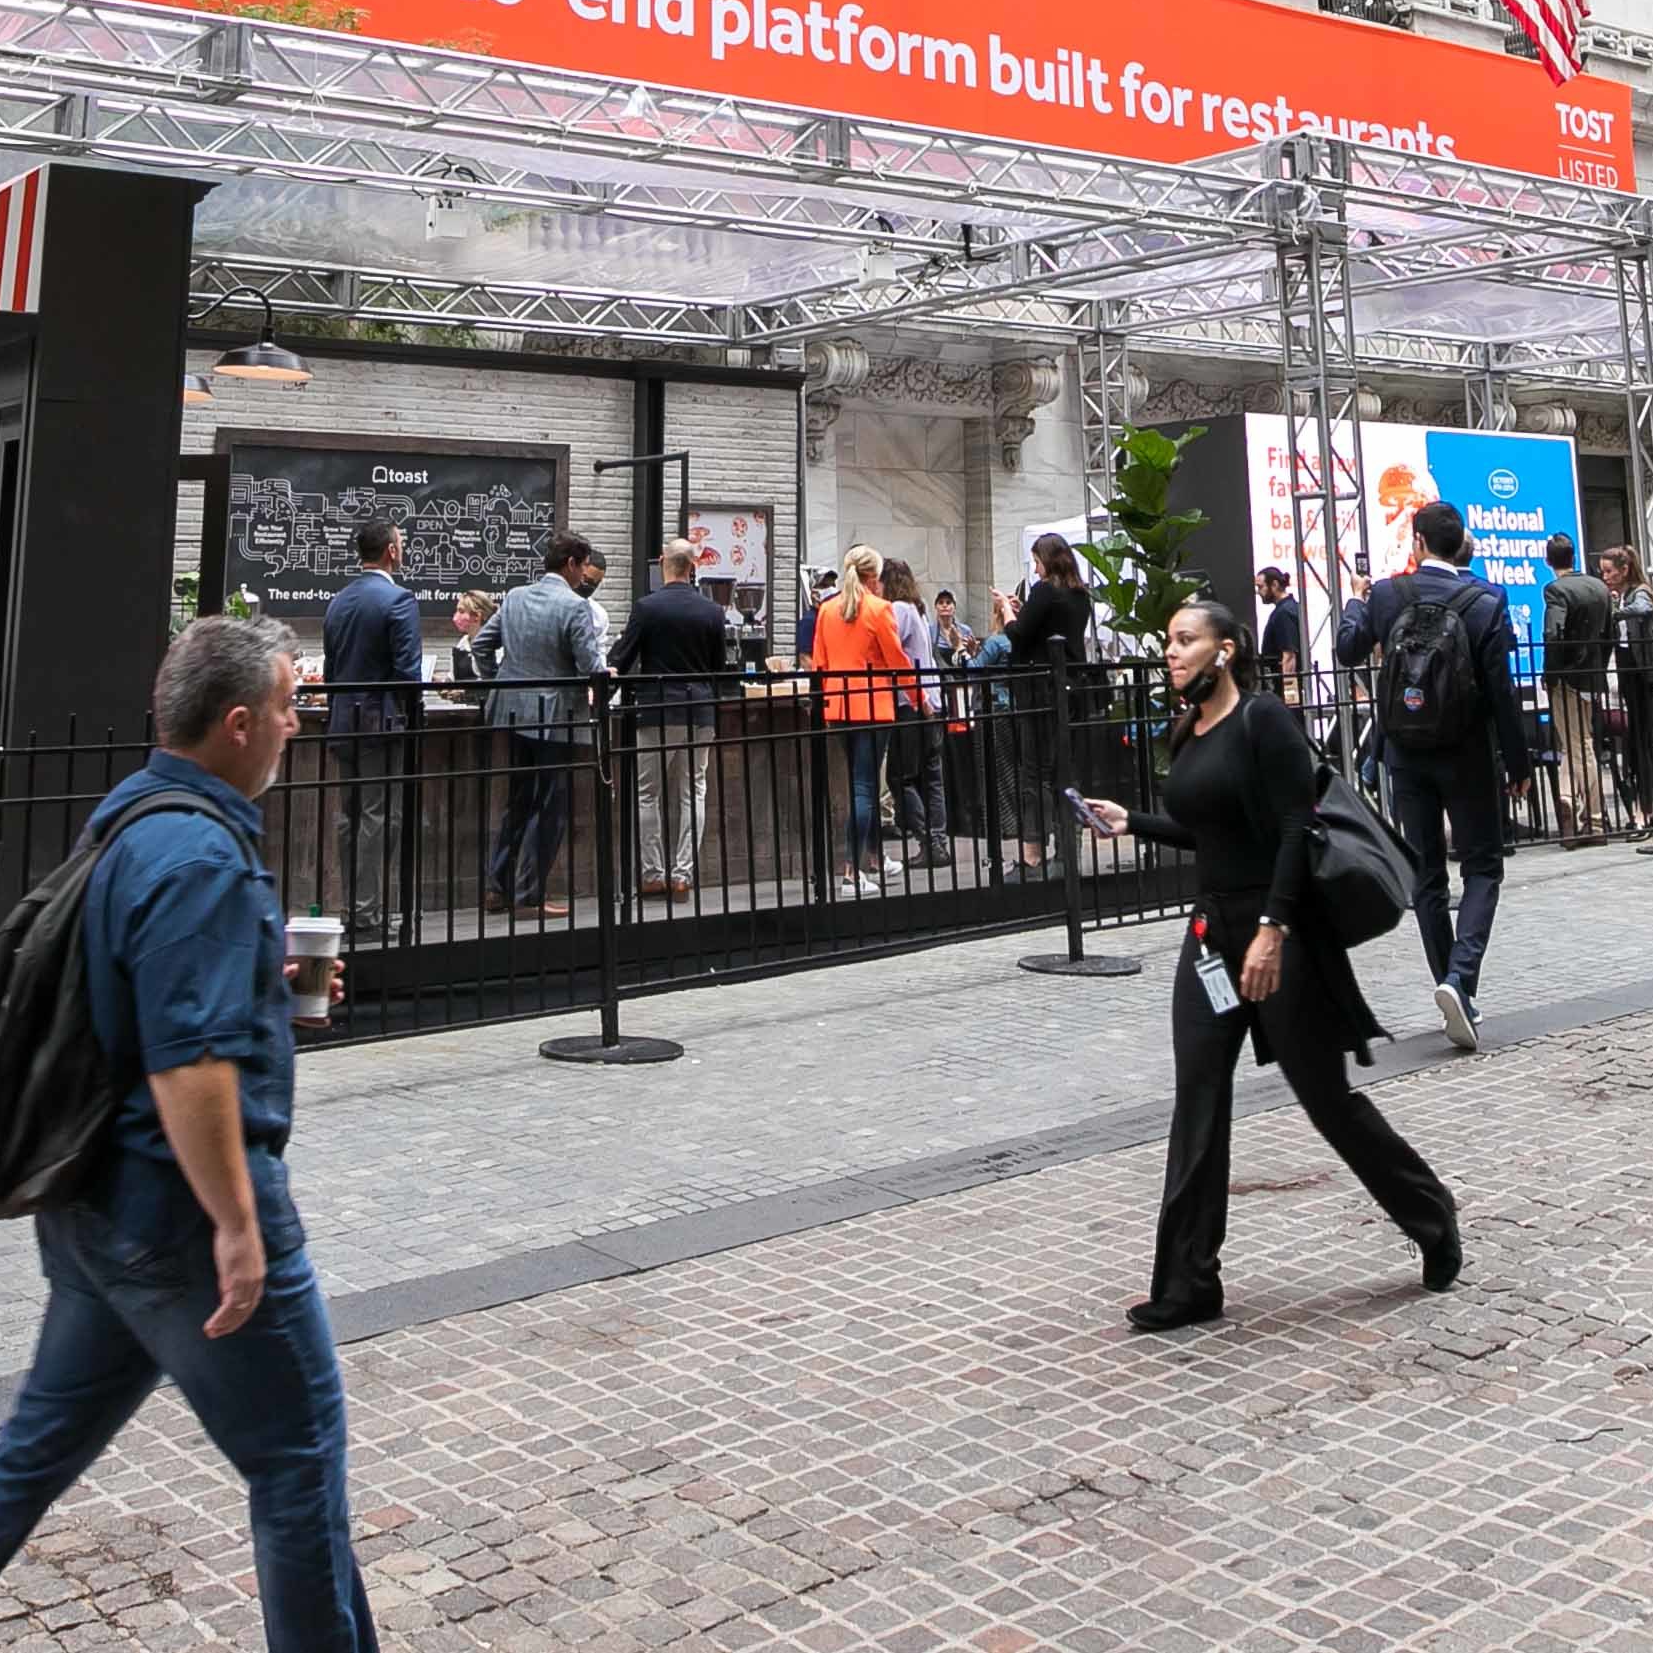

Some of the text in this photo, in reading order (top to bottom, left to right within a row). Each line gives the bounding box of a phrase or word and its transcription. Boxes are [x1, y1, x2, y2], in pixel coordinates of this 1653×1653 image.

[989, 34, 1114, 114] built
[1120, 62, 1193, 127] for
[1202, 93, 1455, 160] restaurants
[1555, 102, 1614, 144] TOST
[1558, 156, 1618, 189] LISTED
[389, 467, 429, 485] toast
[416, 519, 444, 531] OPEN
[1467, 505, 1545, 533] National
[1485, 559, 1537, 586] Week
[268, 588, 290, 601] The
[414, 588, 433, 602] uilt
[434, 589, 451, 602] for
